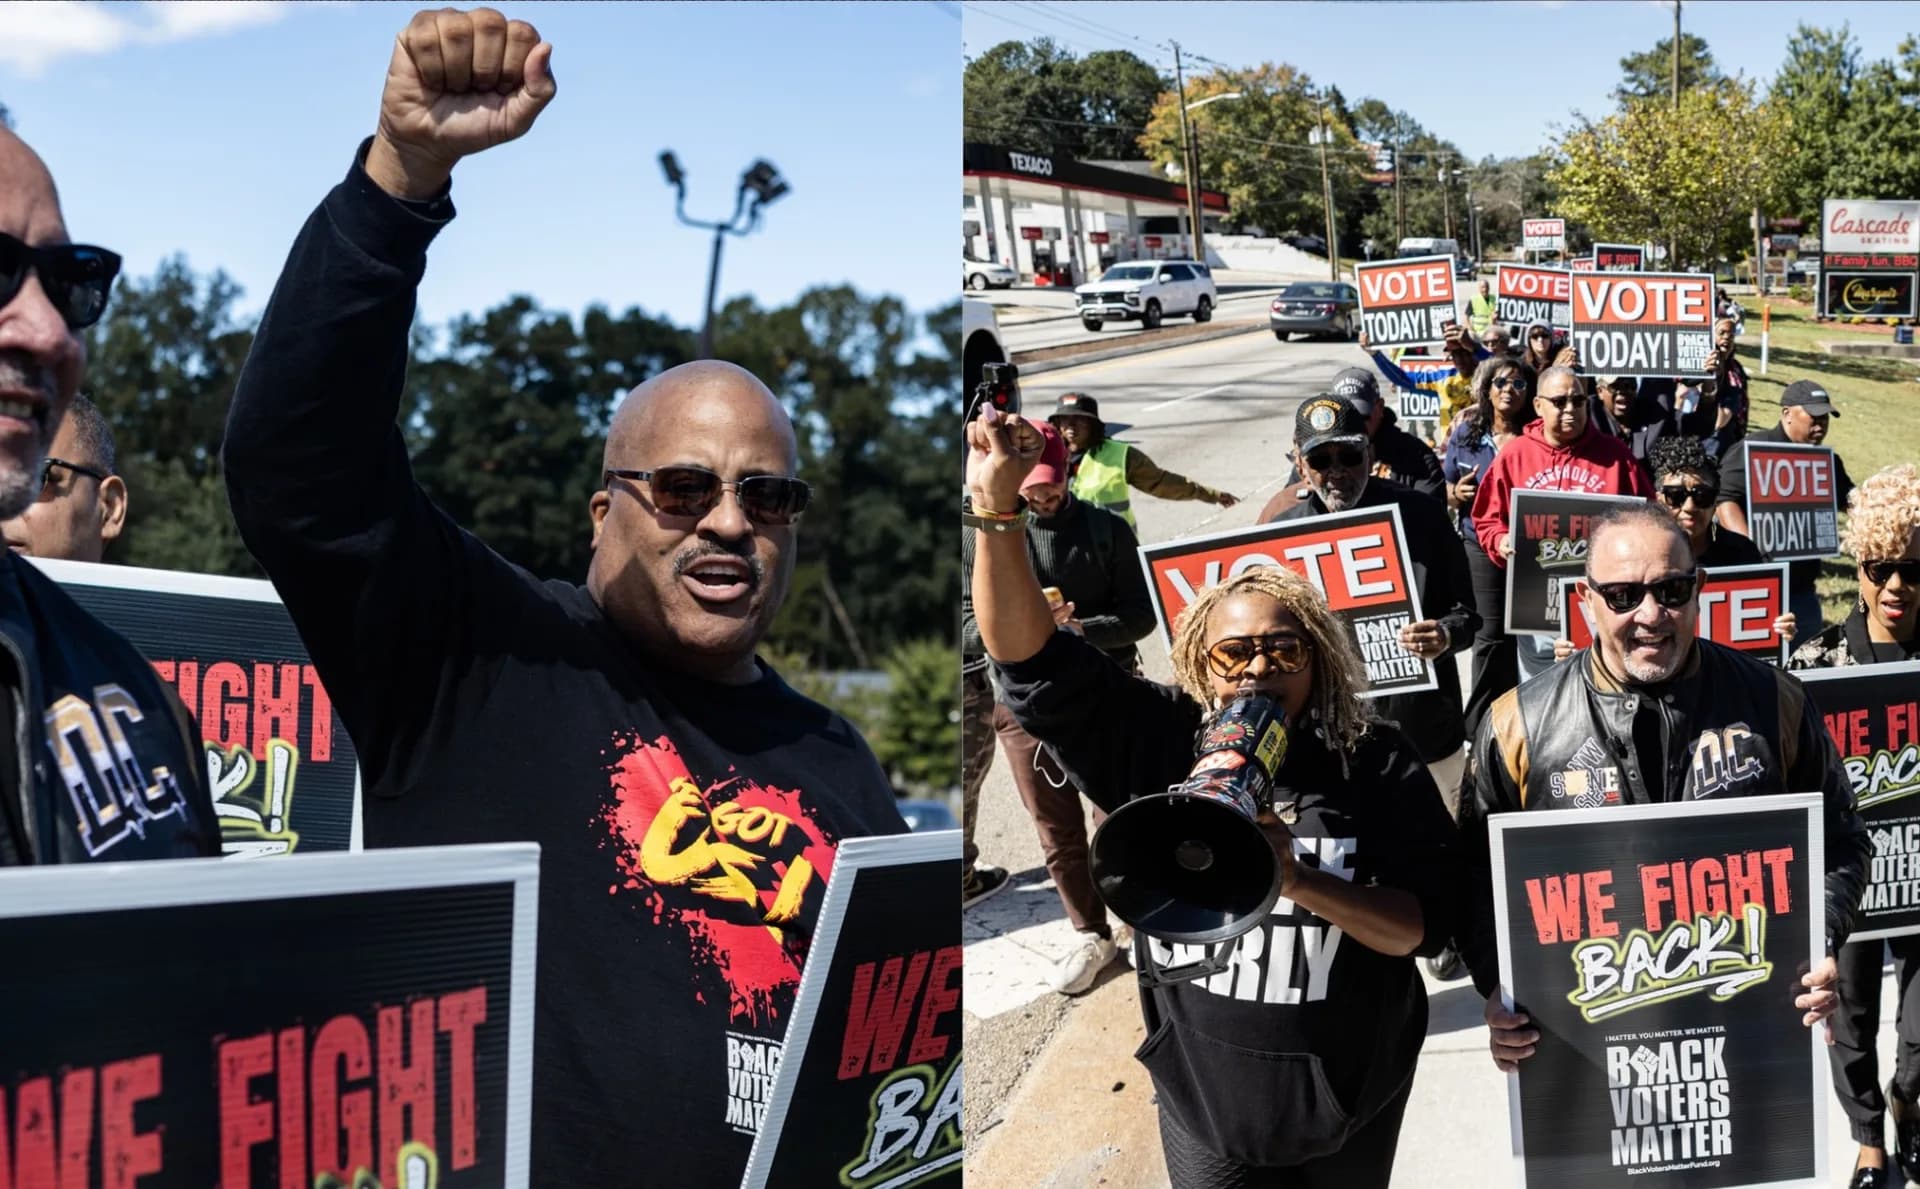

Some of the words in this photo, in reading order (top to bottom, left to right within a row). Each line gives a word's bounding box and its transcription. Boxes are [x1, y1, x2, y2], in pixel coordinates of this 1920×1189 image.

[1009, 152, 1053, 176] TEXACO
[1526, 222, 1561, 235] VOTE
[1830, 208, 1910, 234] Cascade
[1835, 256, 1868, 268] Family
[1362, 267, 1449, 302] VOTE
[1502, 271, 1570, 298] VOTE
[1577, 281, 1706, 322] VOTE
[1364, 308, 1427, 342] TODAY!
[1498, 299, 1549, 322] TODAY!
[1574, 331, 1670, 369] TODAY!
[1677, 334, 1711, 346] BACK
[1753, 459, 1829, 497] VOTE
[1523, 514, 1559, 539] WE
[1752, 511, 1812, 553] TODAY!
[1164, 534, 1394, 608] VTE
[1354, 615, 1410, 644] BAC
[1364, 657, 1424, 682] MATTER
[711, 801, 794, 848] GOT
[1525, 870, 1620, 944] WE
[1639, 848, 1794, 932] FIGHT
[1573, 906, 1764, 1001] BACK!
[838, 945, 960, 1080] WE
[1638, 1031, 1654, 1039] YOU
[1685, 1028, 1696, 1036] WE
[1606, 1037, 1728, 1089] BACK
[0, 1055, 162, 1189] WE
[218, 987, 486, 1189] FIGHT
[1610, 1079, 1730, 1127] VOTERS
[1611, 1119, 1732, 1166] MATTER
[1627, 1160, 1720, 1175] BlackVotersMatterFund.org
